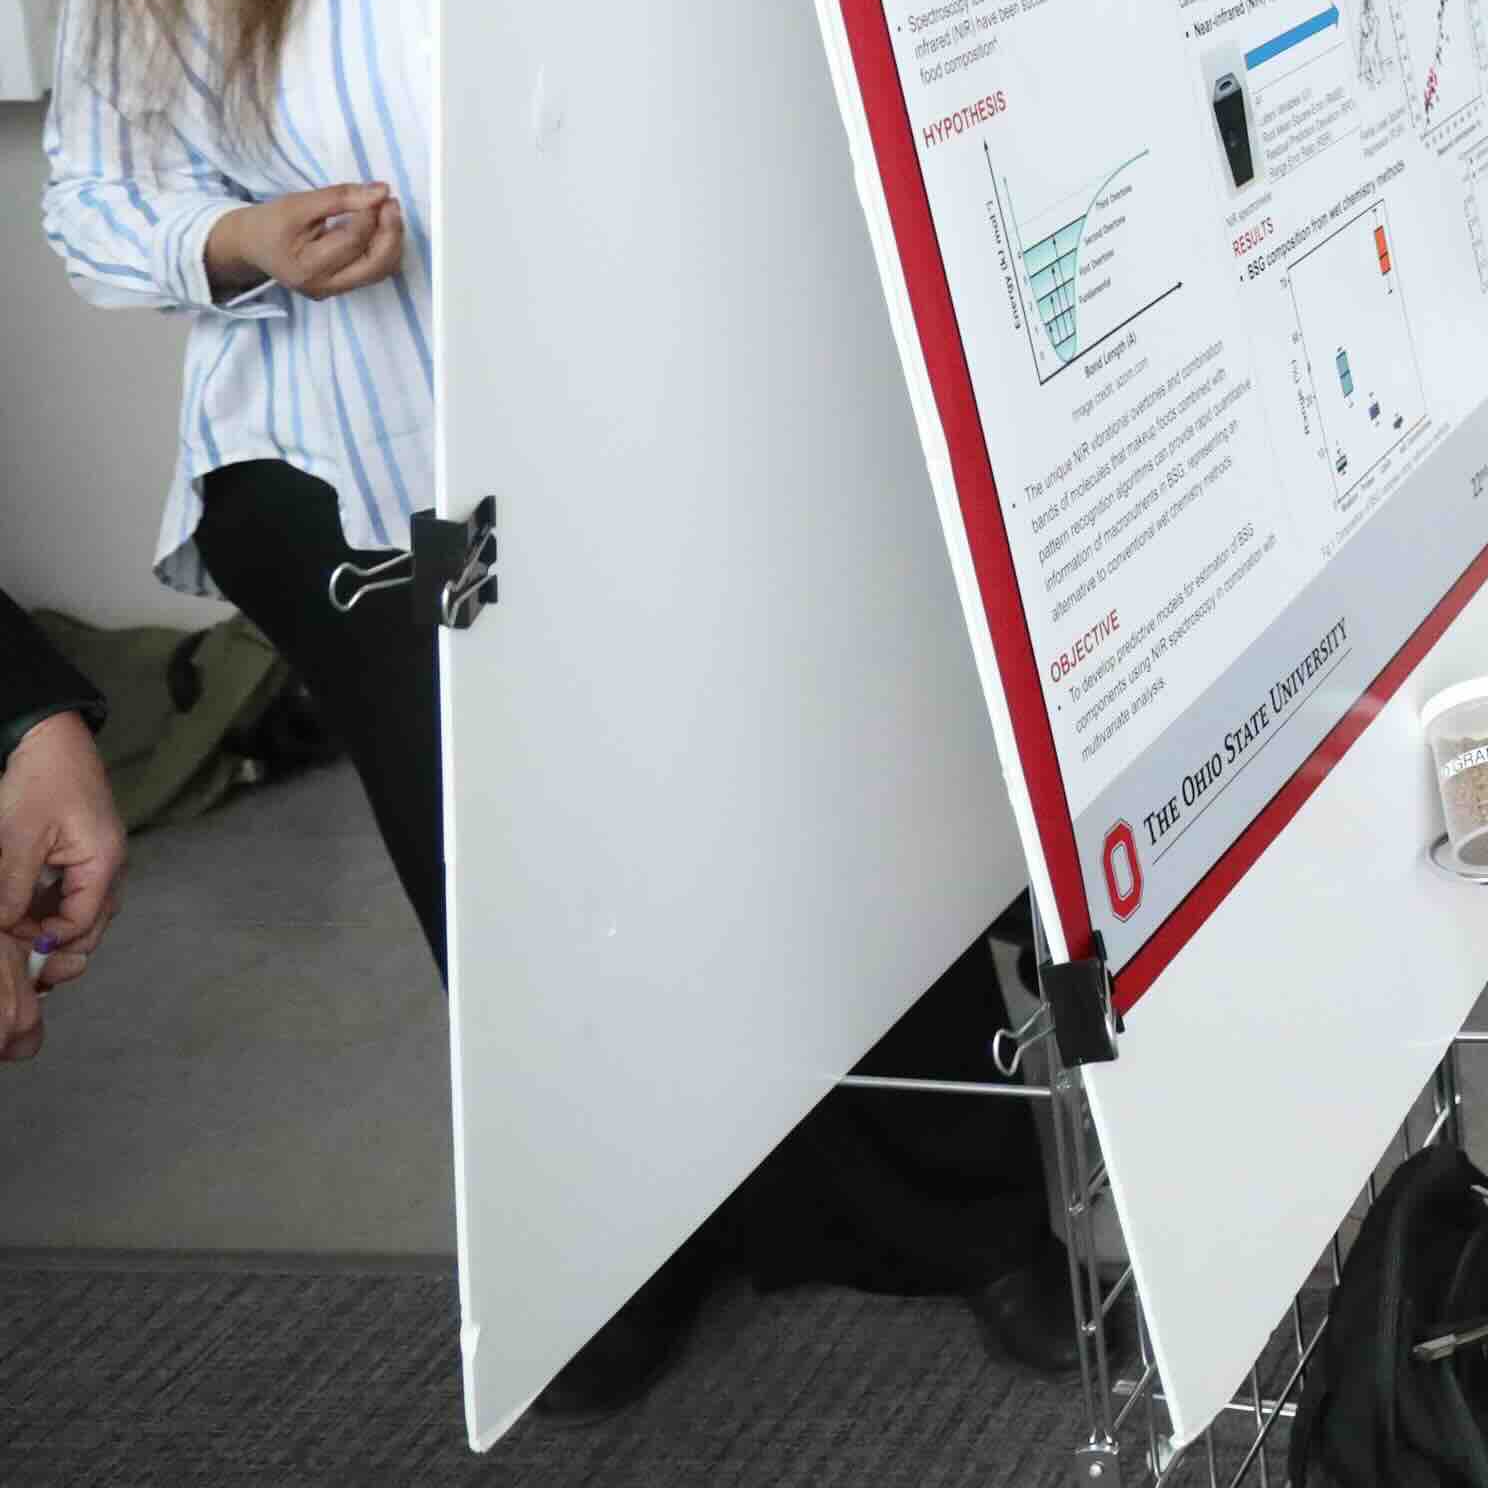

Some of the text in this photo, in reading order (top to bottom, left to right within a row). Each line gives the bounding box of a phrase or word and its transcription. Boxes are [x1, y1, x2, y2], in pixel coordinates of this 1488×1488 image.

[1192, 0, 1245, 38] Near-infrared
[922, 89, 1006, 149] HYPOTHESIS
[1231, 216, 1274, 257] RESULTS
[1247, 255, 1266, 280] BSG
[1266, 223, 1311, 267] composition
[1310, 213, 1328, 232] from
[1023, 479, 1044, 502] The
[1072, 440, 1091, 465] NIR
[1031, 498, 1060, 534] bands
[1038, 528, 1071, 569] pattern
[1043, 544, 1095, 593] information
[1049, 575, 1096, 623] alternative
[1050, 608, 1120, 683] OBJECTIVE
[1079, 654, 1116, 696] develop
[1116, 616, 1157, 664] predictive
[1156, 591, 1185, 626] models
[1071, 677, 1128, 734] components
[1127, 655, 1152, 685] using
[1149, 636, 1168, 663] NIR
[1143, 617, 1349, 846] THE OHIO STATE UNIVERSITY
